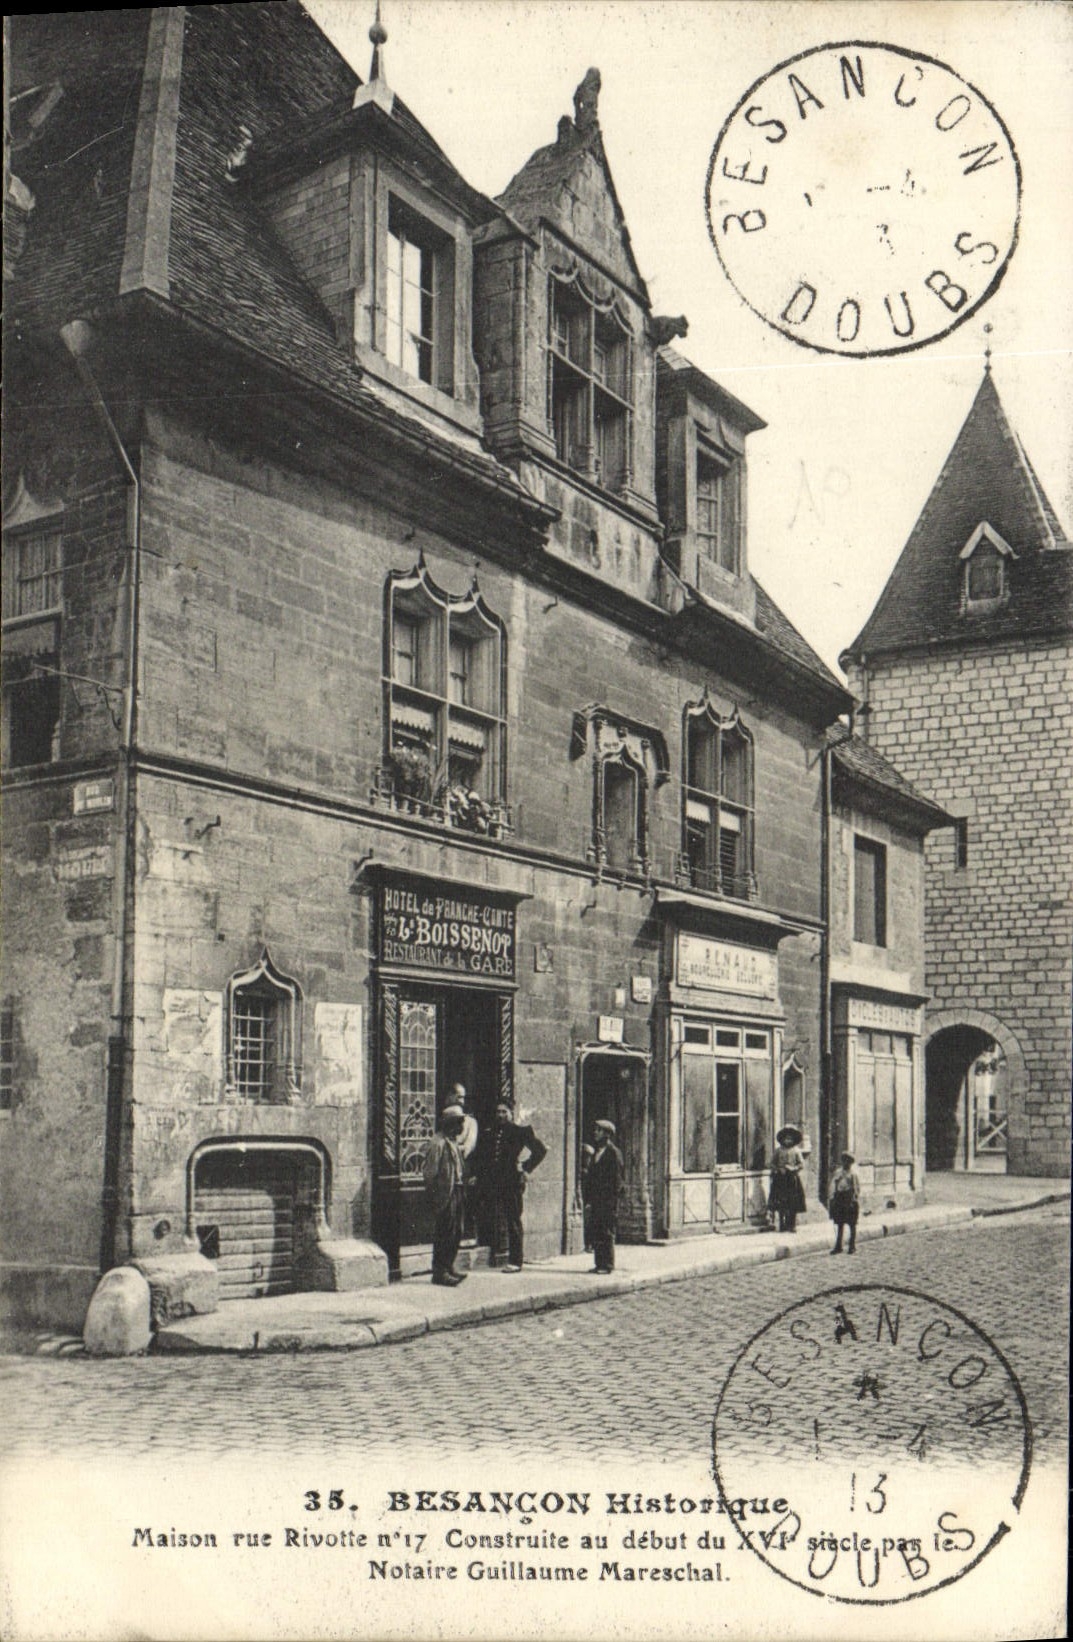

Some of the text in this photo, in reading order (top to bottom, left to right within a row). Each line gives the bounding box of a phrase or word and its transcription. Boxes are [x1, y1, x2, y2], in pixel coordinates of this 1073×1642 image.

[384, 887, 419, 914] HOTEL
[422, 898, 434, 916] de
[470, 955, 513, 976] GARE
